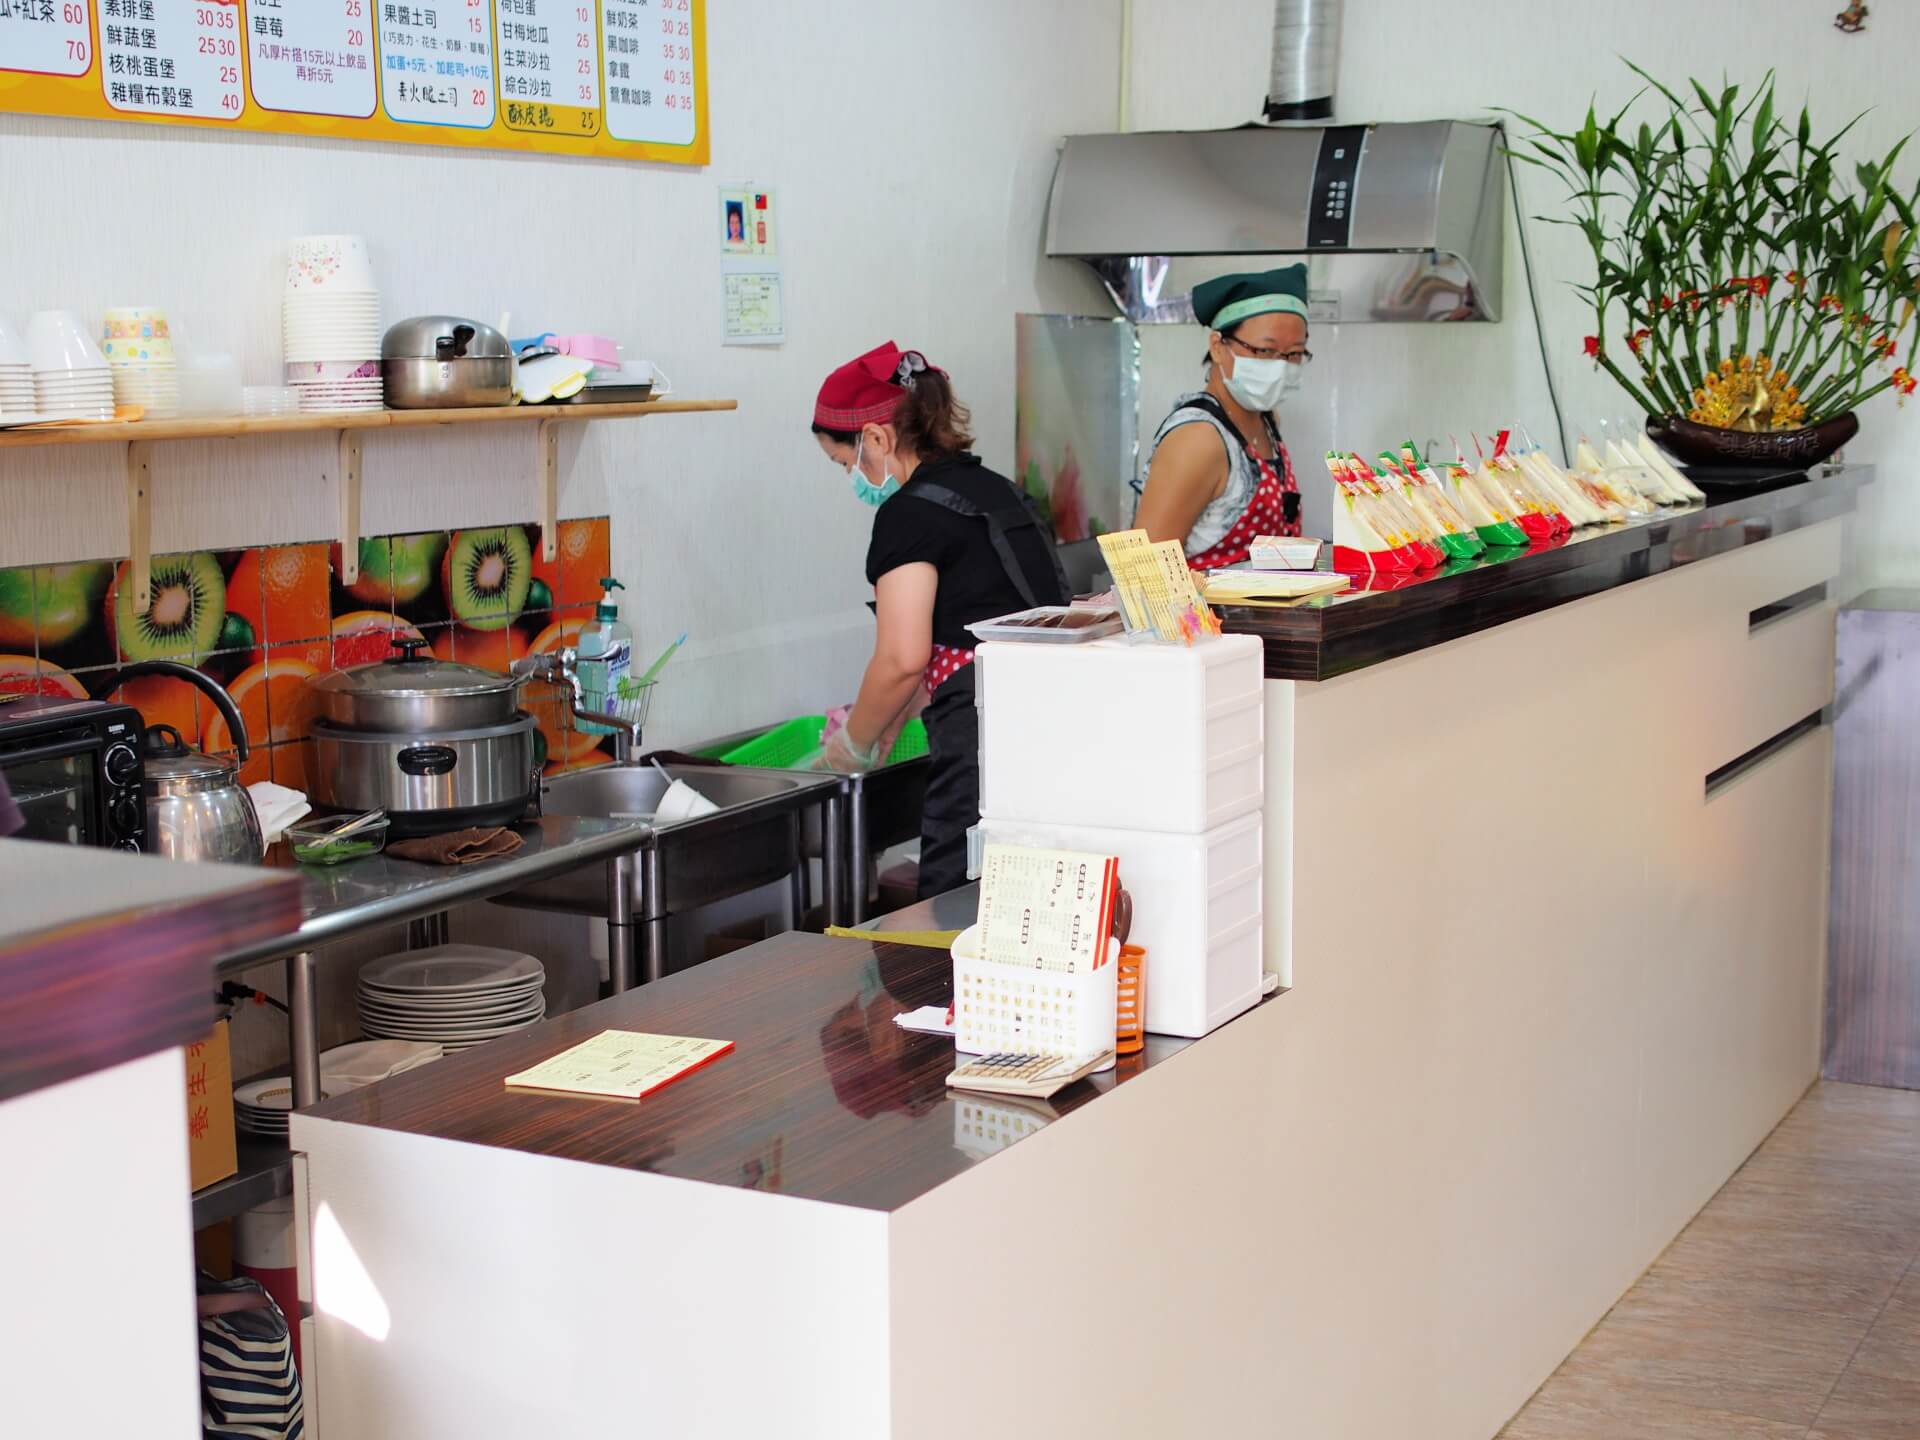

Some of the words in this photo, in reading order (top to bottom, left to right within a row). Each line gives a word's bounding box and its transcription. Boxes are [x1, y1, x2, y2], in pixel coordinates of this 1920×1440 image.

[63, 4, 83, 24] 60
[105, 0, 155, 20] 素排堡
[196, 9, 213, 26] 30
[216, 11, 234, 29] 35
[346, 0, 362, 16] 25
[384, 4, 437, 29] 果醬土司
[468, 17, 482, 33] 15
[576, 7, 588, 22] 10
[254, 16, 283, 38] 草莓
[347, 29, 363, 46] 20
[502, 21, 549, 44] 甘梅地瓜
[576, 33, 590, 48] 25
[606, 9, 638, 29] 鮮奶茶
[662, 19, 674, 34] 30
[677, 22, 689, 36] 25
[66, 40, 85, 61] 70
[106, 24, 157, 49] 鮮蔬堡
[198, 37, 216, 54] 25
[218, 39, 235, 56] 30
[607, 35, 640, 56] 黑咖啡
[663, 44, 675, 59] 35
[678, 46, 690, 61] 30
[109, 53, 175, 79] 核桃蛋堡
[220, 66, 238, 83] 25
[503, 49, 551, 71] 生菜沙拉
[578, 59, 591, 74] 25
[296, 65, 335, 83] 再折5元
[663, 70, 676, 84] 40
[679, 71, 691, 85] 35
[111, 82, 193, 108] 雜糧布穀堡
[222, 94, 239, 110] 40
[472, 89, 486, 106] 20
[504, 76, 552, 97] 綜合沙拉
[578, 85, 592, 100] 35
[664, 94, 676, 109] 40
[680, 96, 692, 110] 35
[581, 111, 594, 129] 25
